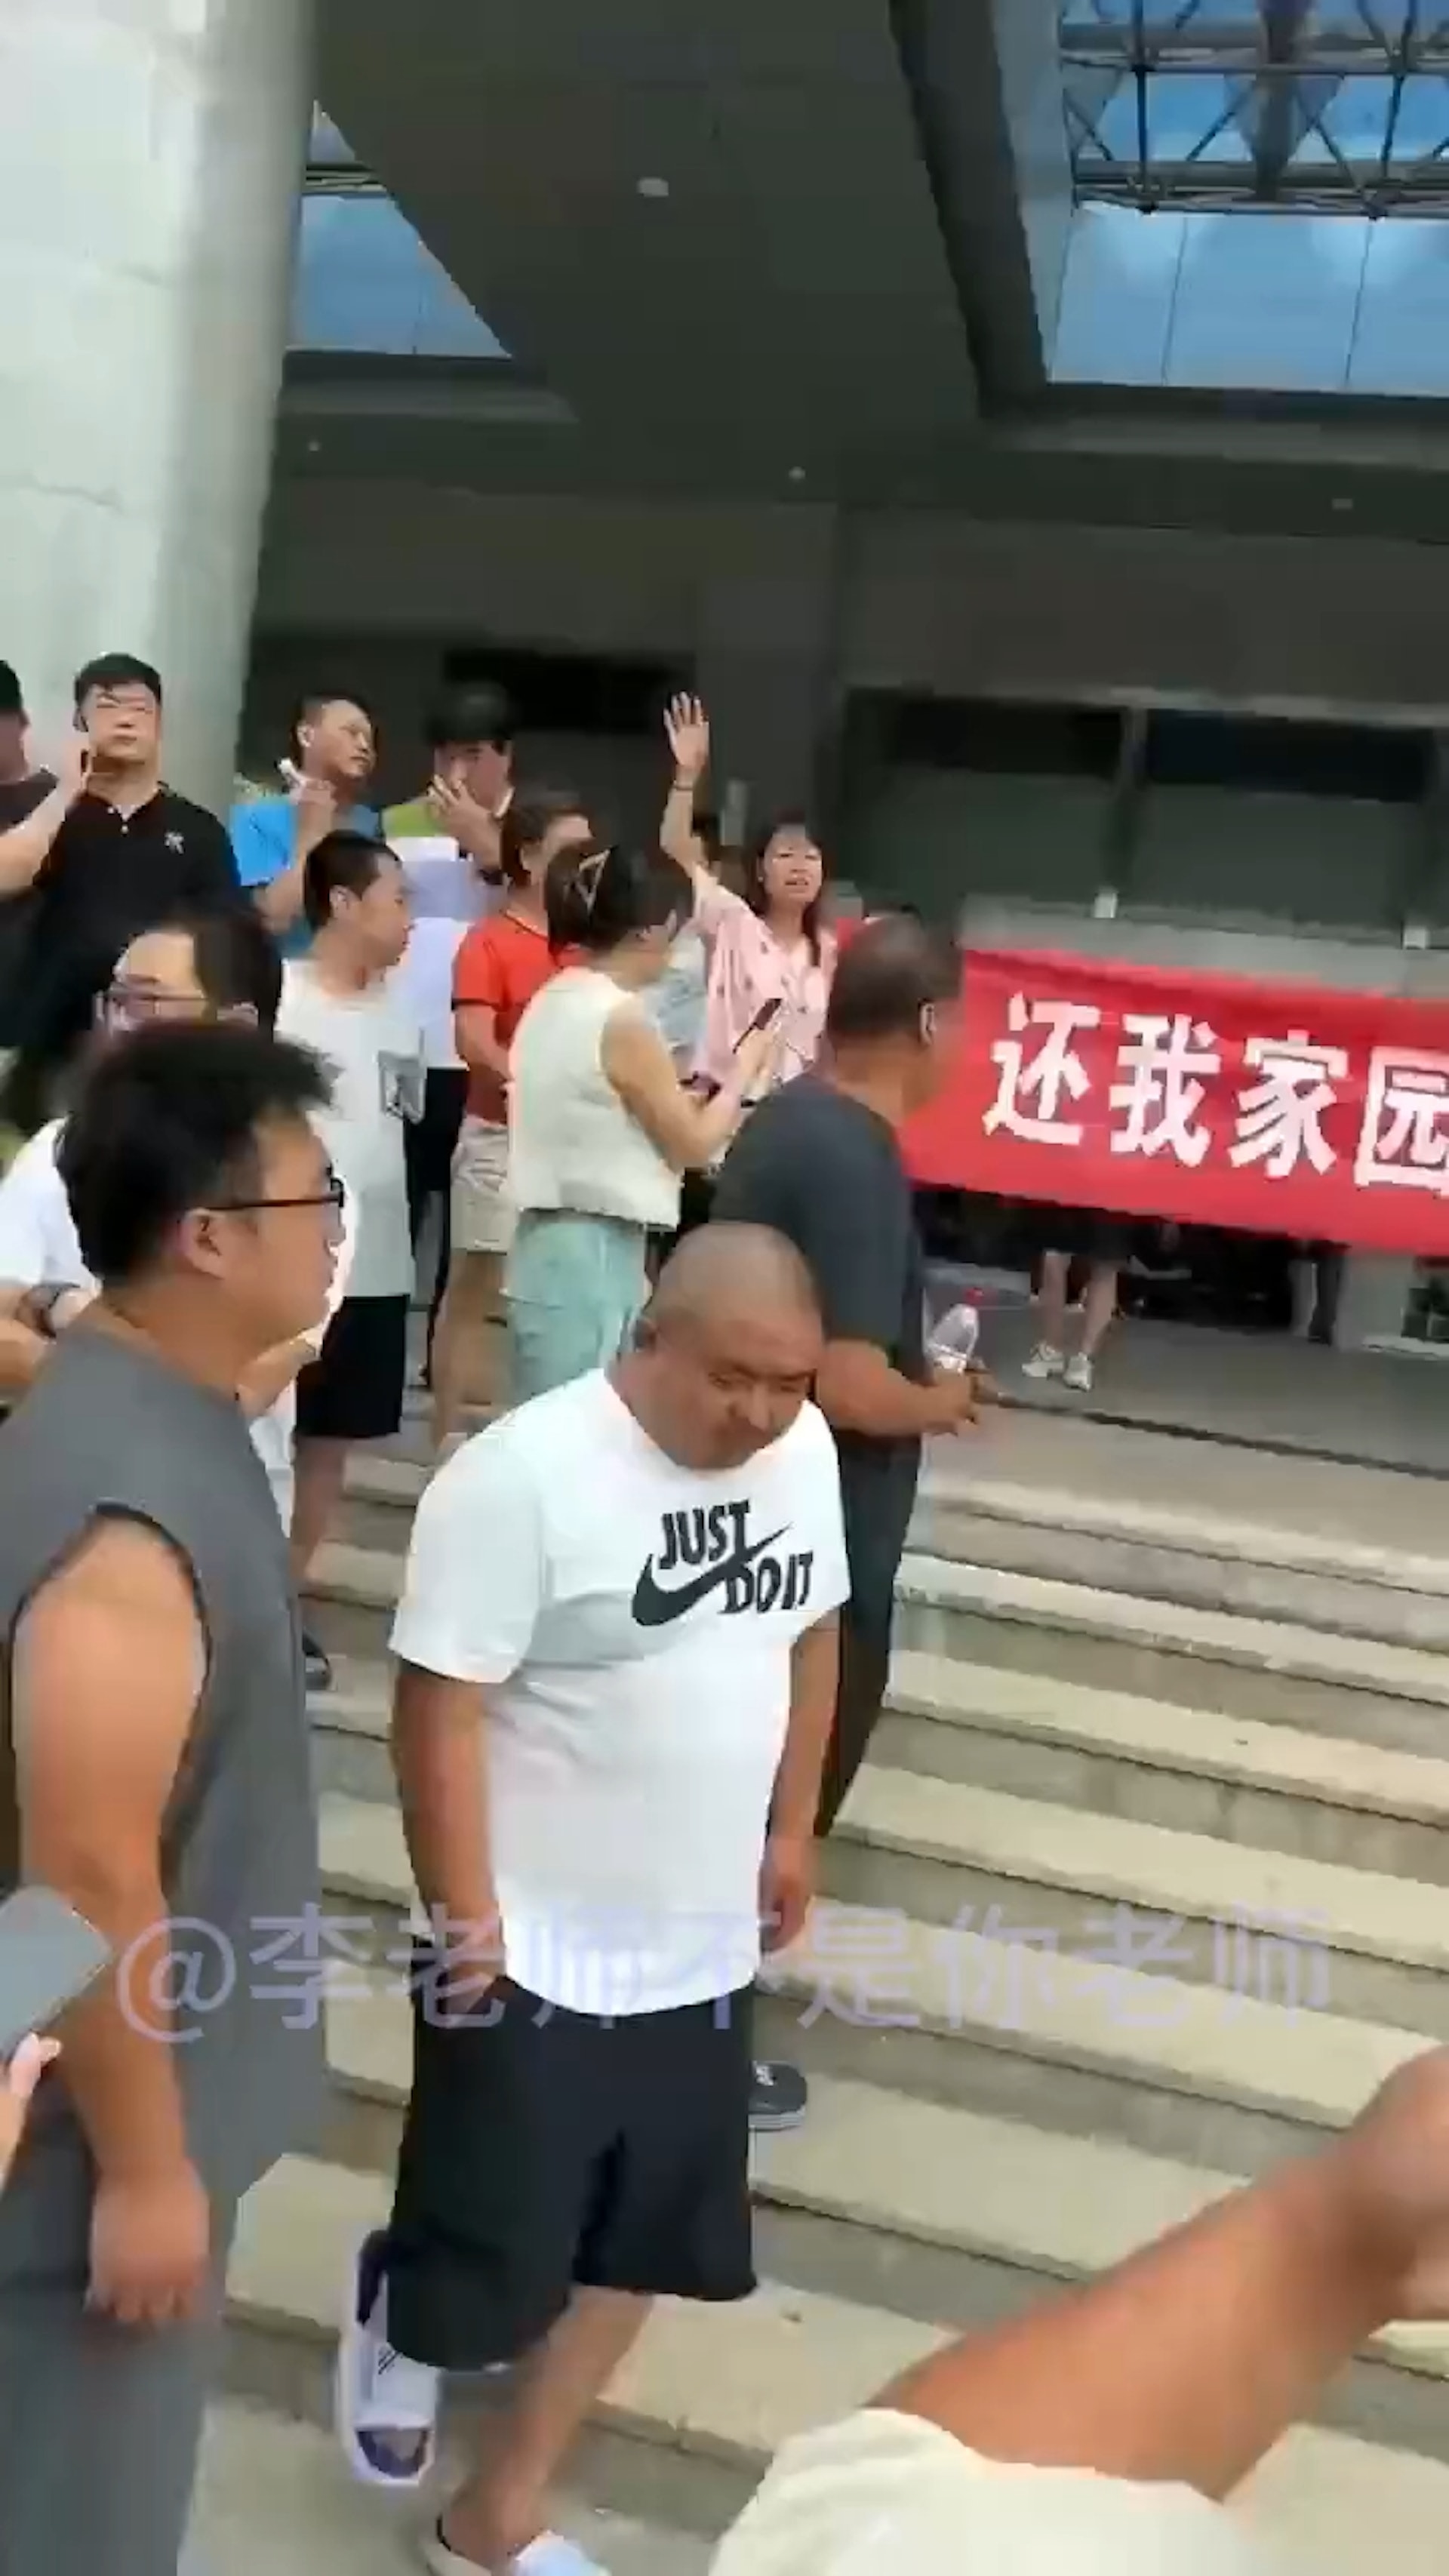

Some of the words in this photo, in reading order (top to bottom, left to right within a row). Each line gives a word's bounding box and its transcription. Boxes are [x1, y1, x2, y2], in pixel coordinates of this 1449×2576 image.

[982, 990, 1449, 1198] 还我家园
[657, 1498, 750, 1571] JUST
